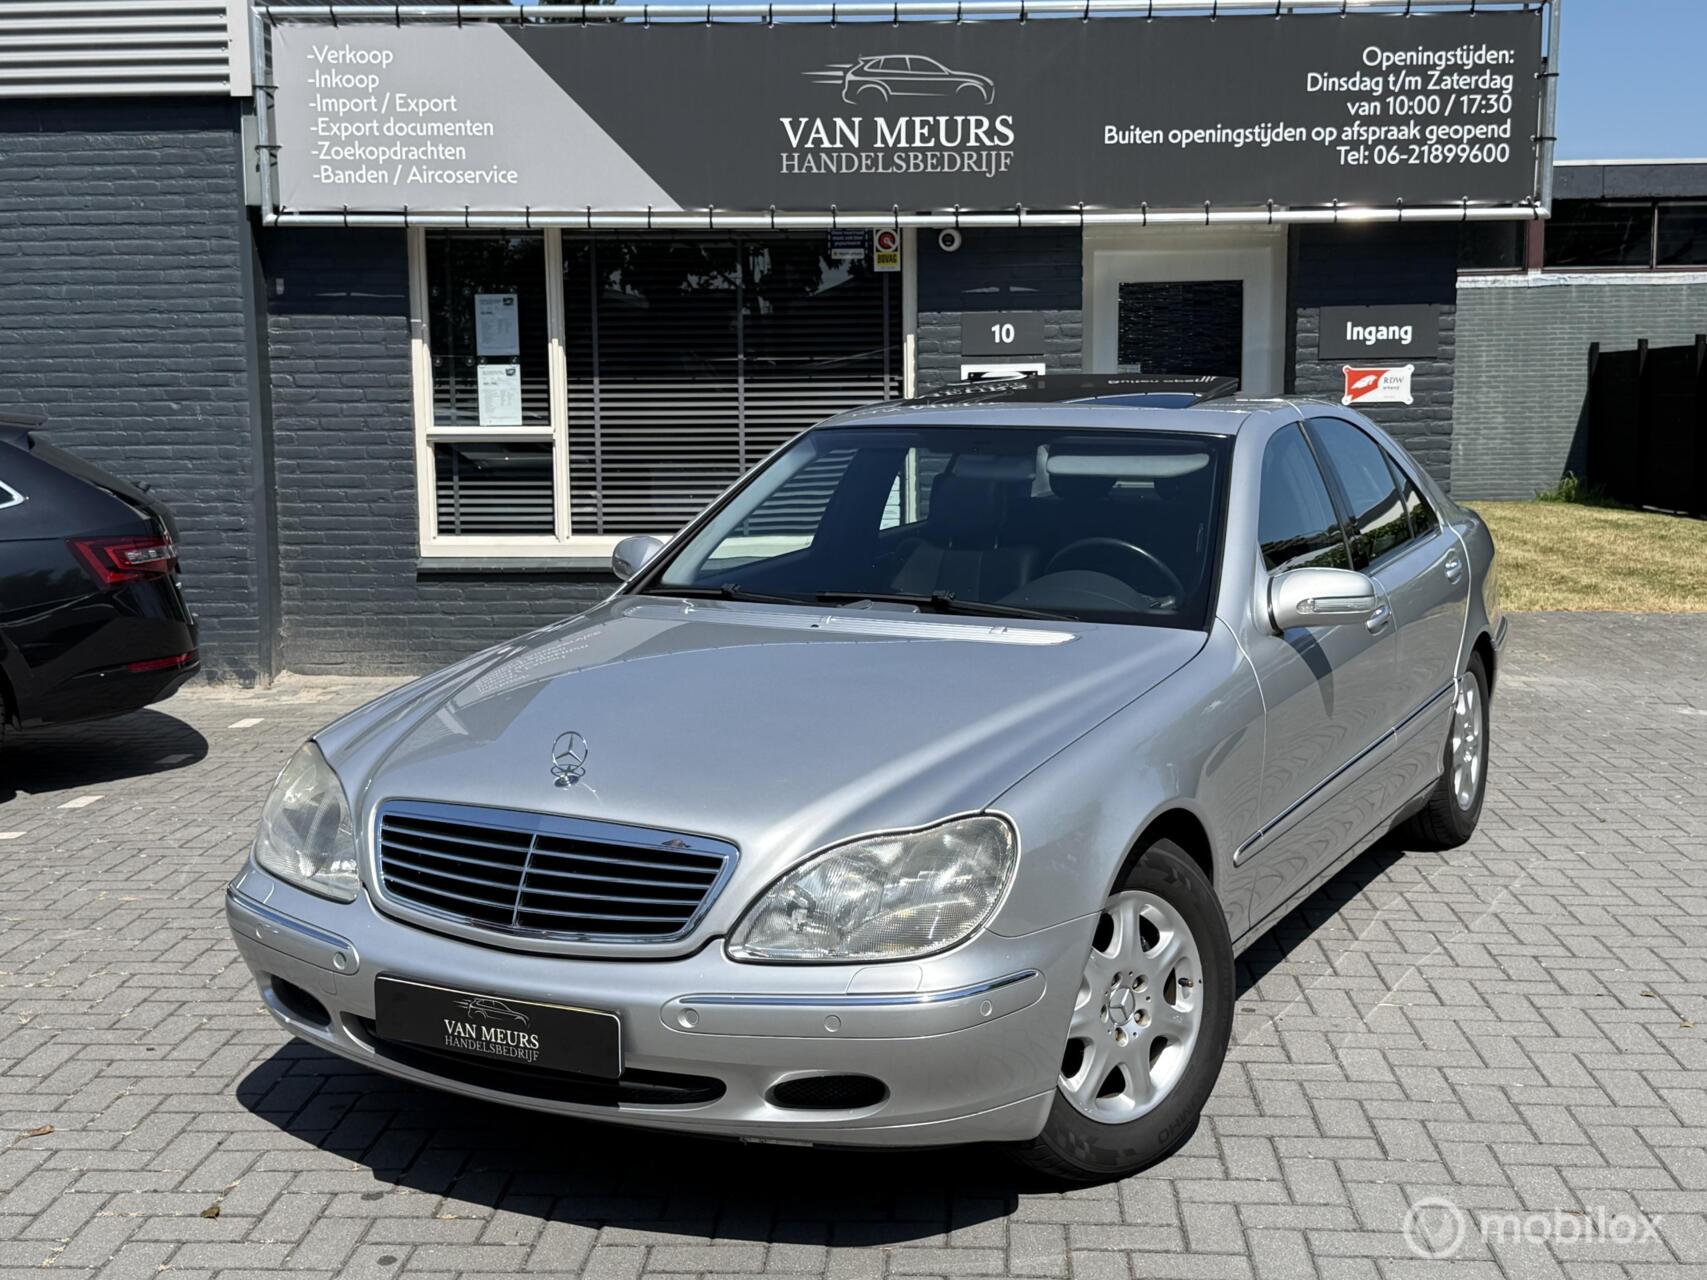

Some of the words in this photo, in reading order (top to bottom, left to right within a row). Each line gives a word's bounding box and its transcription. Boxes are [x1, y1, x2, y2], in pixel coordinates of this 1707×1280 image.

[307, 45, 394, 68] -Verkoop
[1362, 44, 1515, 70] Openingstijden:
[307, 69, 380, 91] -Inkoop
[1306, 71, 1383, 95] Dinsdag
[1387, 71, 1422, 93] t/m
[1426, 69, 1514, 94] Zaterdag
[308, 94, 377, 116] -Import
[381, 94, 391, 114] /
[395, 94, 458, 116] Export
[1346, 101, 1381, 117] van
[1386, 95, 1441, 116] 10:00
[1444, 95, 1455, 117] /
[1459, 93, 1513, 114] 17:30
[309, 118, 379, 141] -Export
[383, 118, 494, 137] documenten
[779, 117, 863, 149] VAN
[873, 115, 1015, 148] MEURS
[1104, 125, 1164, 145] Buiten
[1168, 123, 1307, 148] openingstijden
[1311, 126, 1338, 145] op
[1342, 120, 1421, 145] afspraak
[1425, 119, 1512, 144] geopend
[311, 141, 467, 164] -Zoekopdrachten
[780, 151, 1014, 178] HANDELSBEDRIJF
[1335, 145, 1370, 165] Tel:
[1373, 143, 1511, 165] 06-21899600
[312, 165, 388, 185] -Banden
[393, 165, 403, 186] /
[406, 165, 518, 185] Aircoservice
[990, 323, 1016, 344] 10
[1346, 321, 1413, 346] Ingang
[444, 1018, 477, 1039] VAN
[481, 1025, 540, 1050] MEURS
[444, 1034, 541, 1063] HANDELSBEDRIJF
